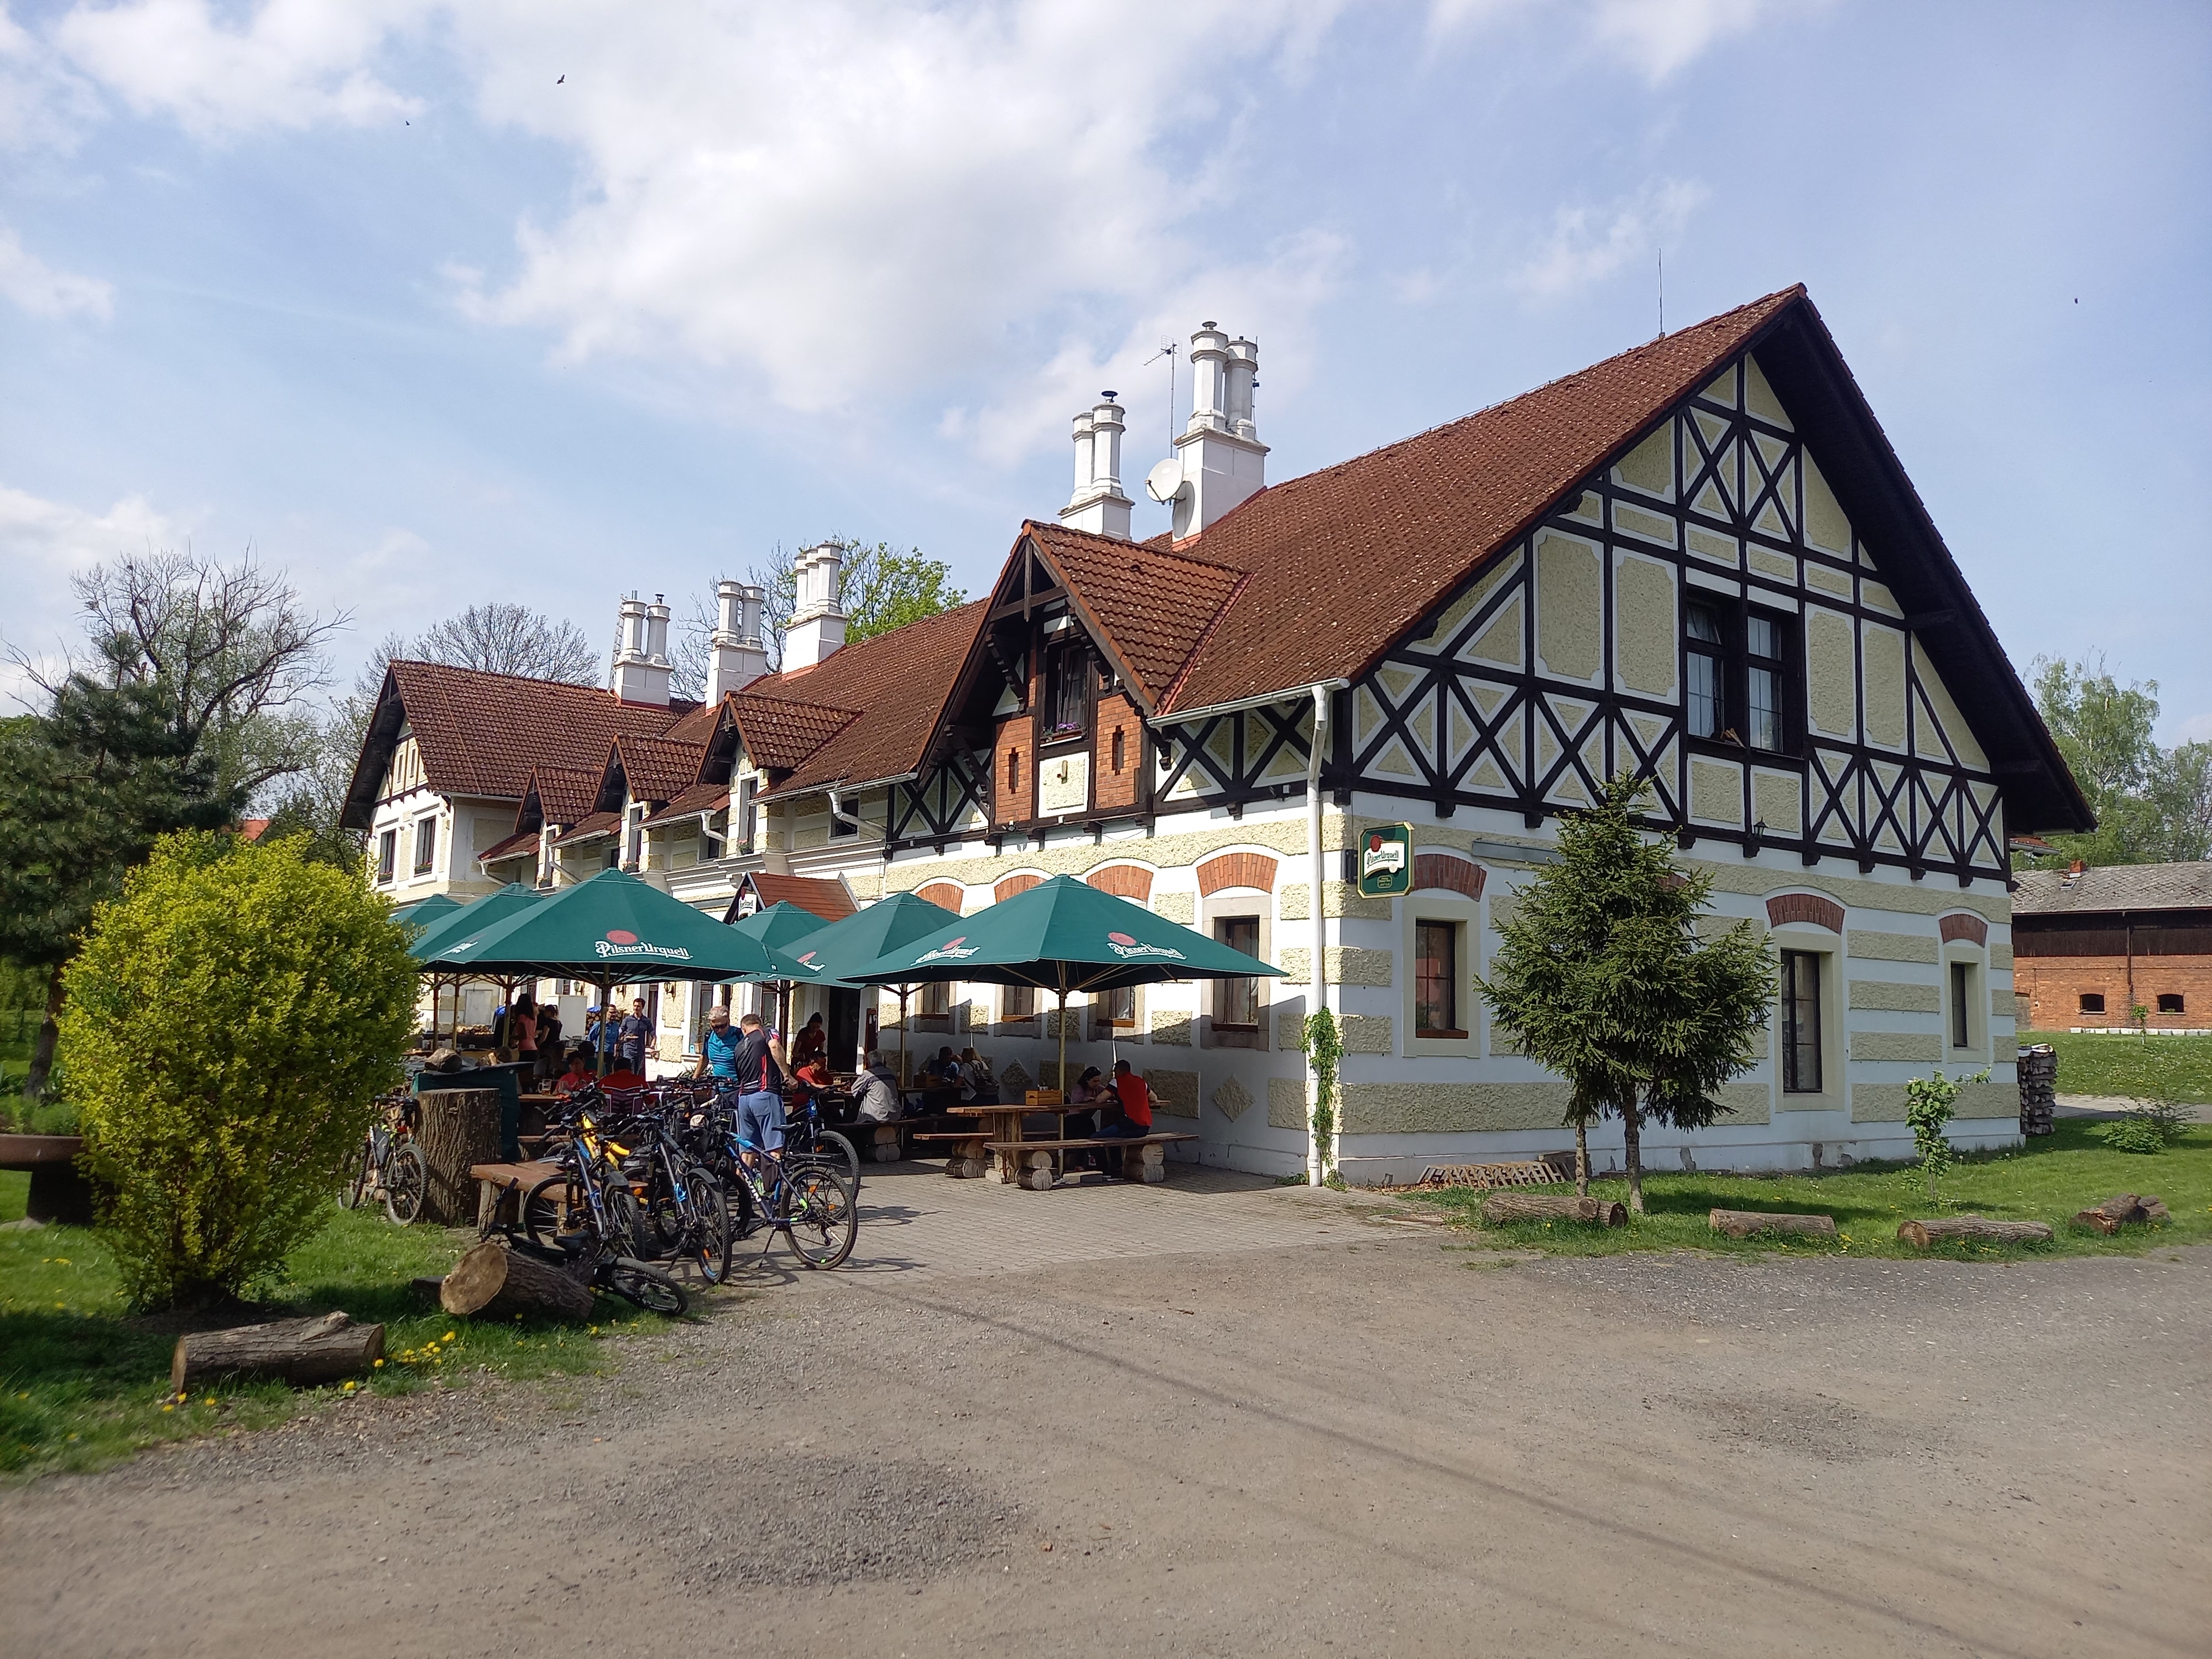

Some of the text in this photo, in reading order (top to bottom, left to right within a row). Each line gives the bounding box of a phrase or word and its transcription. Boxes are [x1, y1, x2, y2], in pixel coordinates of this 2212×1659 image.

[1381, 849, 1399, 863] Urquell
[595, 941, 690, 958] Pilsner Urquell
[1107, 943, 1148, 958] Pilsner
